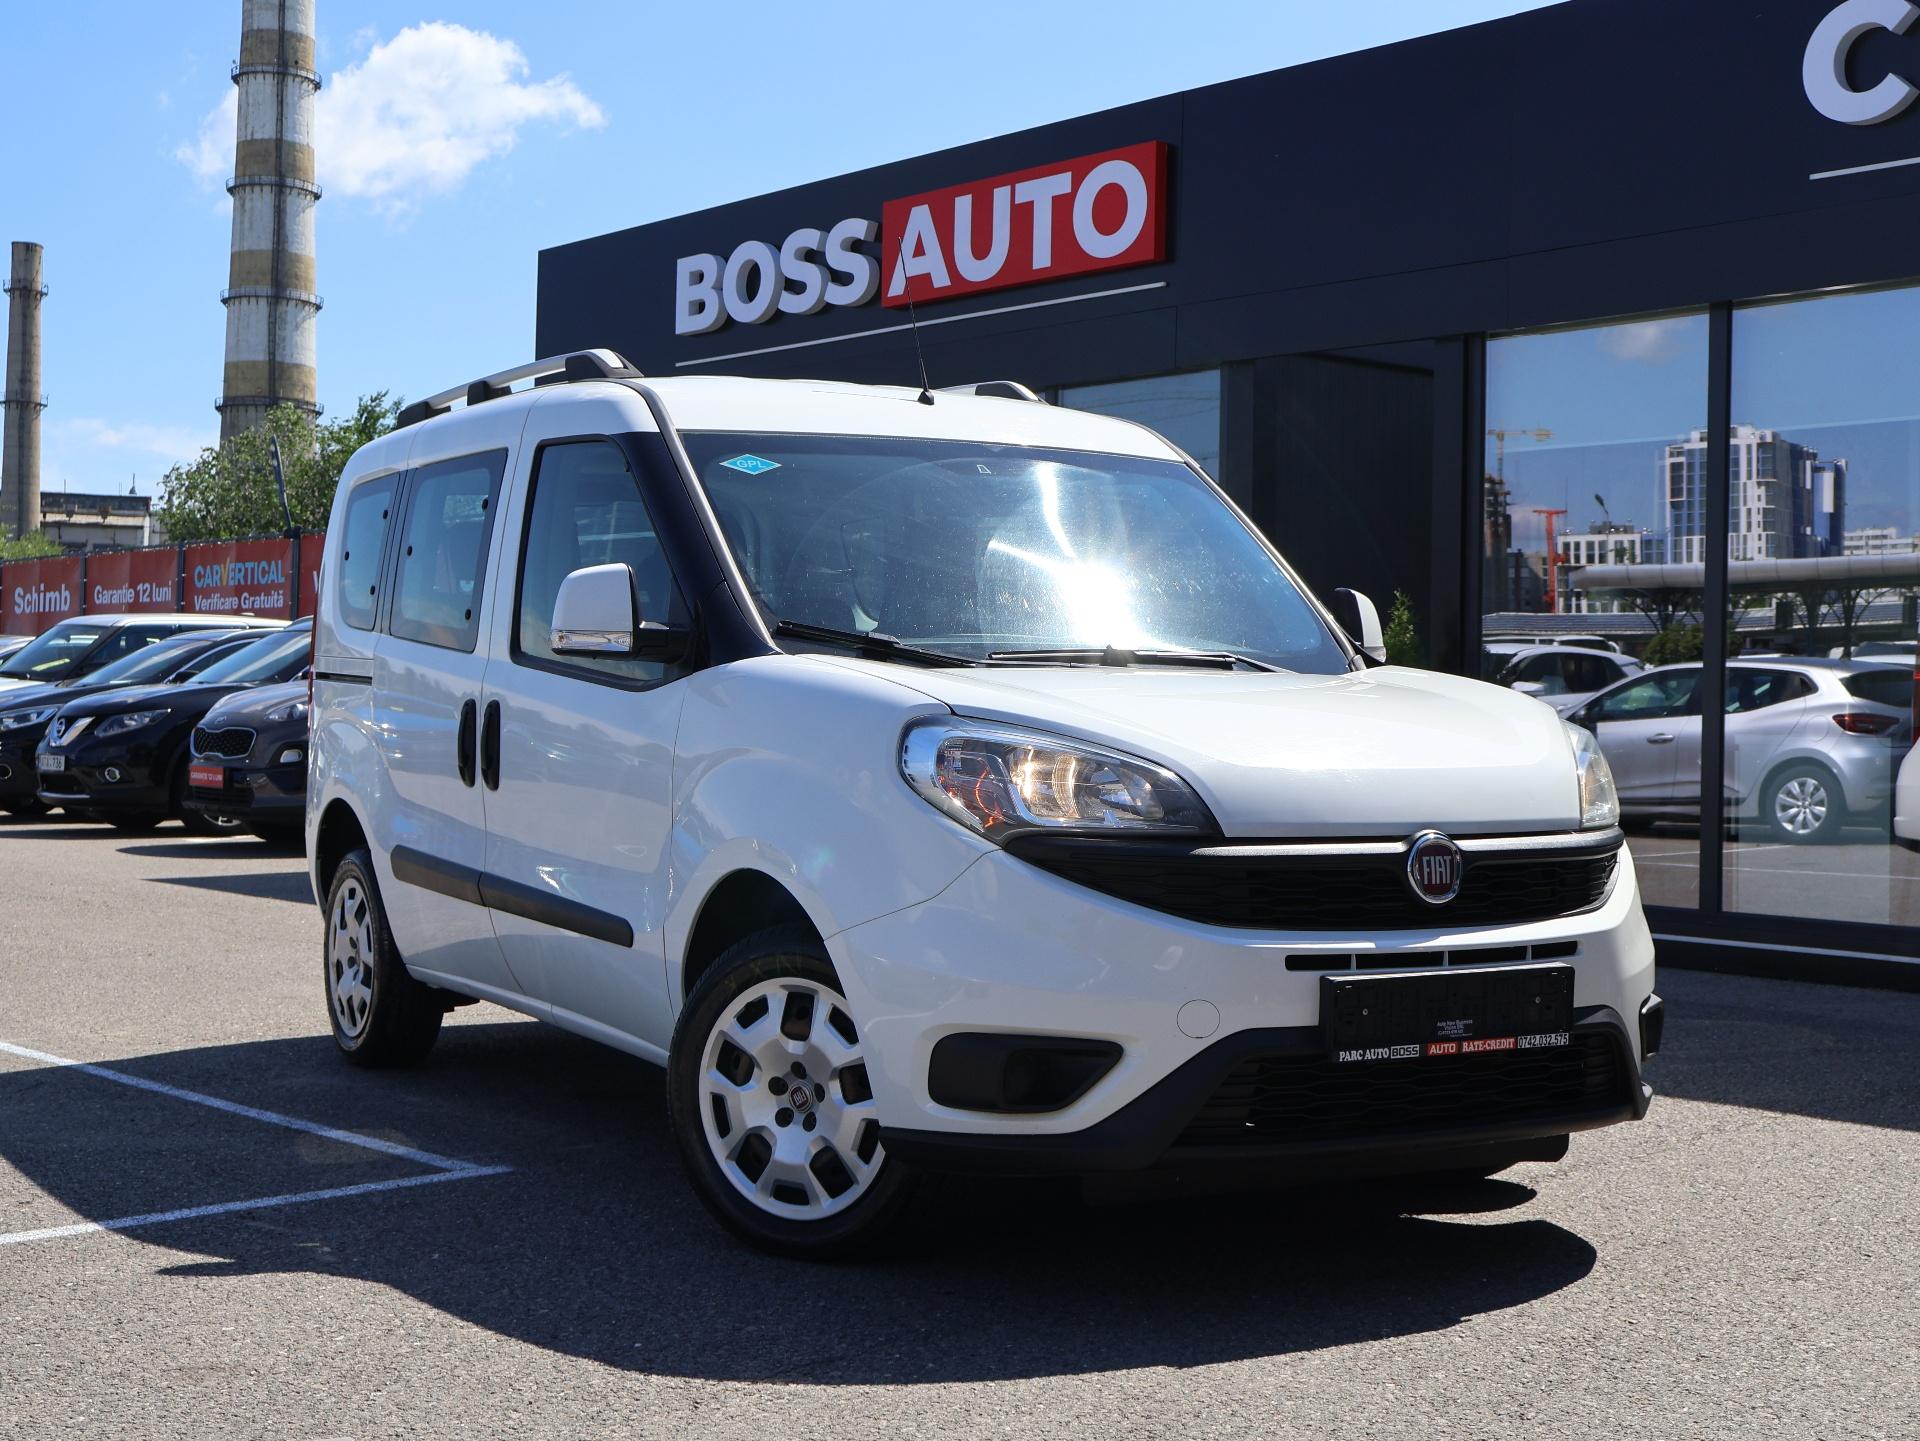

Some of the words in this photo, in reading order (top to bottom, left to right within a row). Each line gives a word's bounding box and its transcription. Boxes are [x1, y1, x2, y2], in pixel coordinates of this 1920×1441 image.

[675, 217, 880, 336] BOSS
[887, 159, 1148, 298] AUTO
[736, 460, 766, 468] GPL
[194, 558, 285, 588] CARVERTICAL
[14, 582, 71, 614] Schimb
[137, 583, 150, 602] 12
[152, 580, 172, 602] luni
[194, 592, 239, 611] Verificare
[240, 590, 284, 609] Gratuită
[1422, 855, 1452, 885] FIAT
[1339, 1050, 1364, 1062] PARC
[1364, 1047, 1389, 1060] AUTO
[1391, 1045, 1419, 1059] BOSS
[1429, 1043, 1456, 1055] AUTO
[1462, 1038, 1515, 1052] RATE-CREDIT
